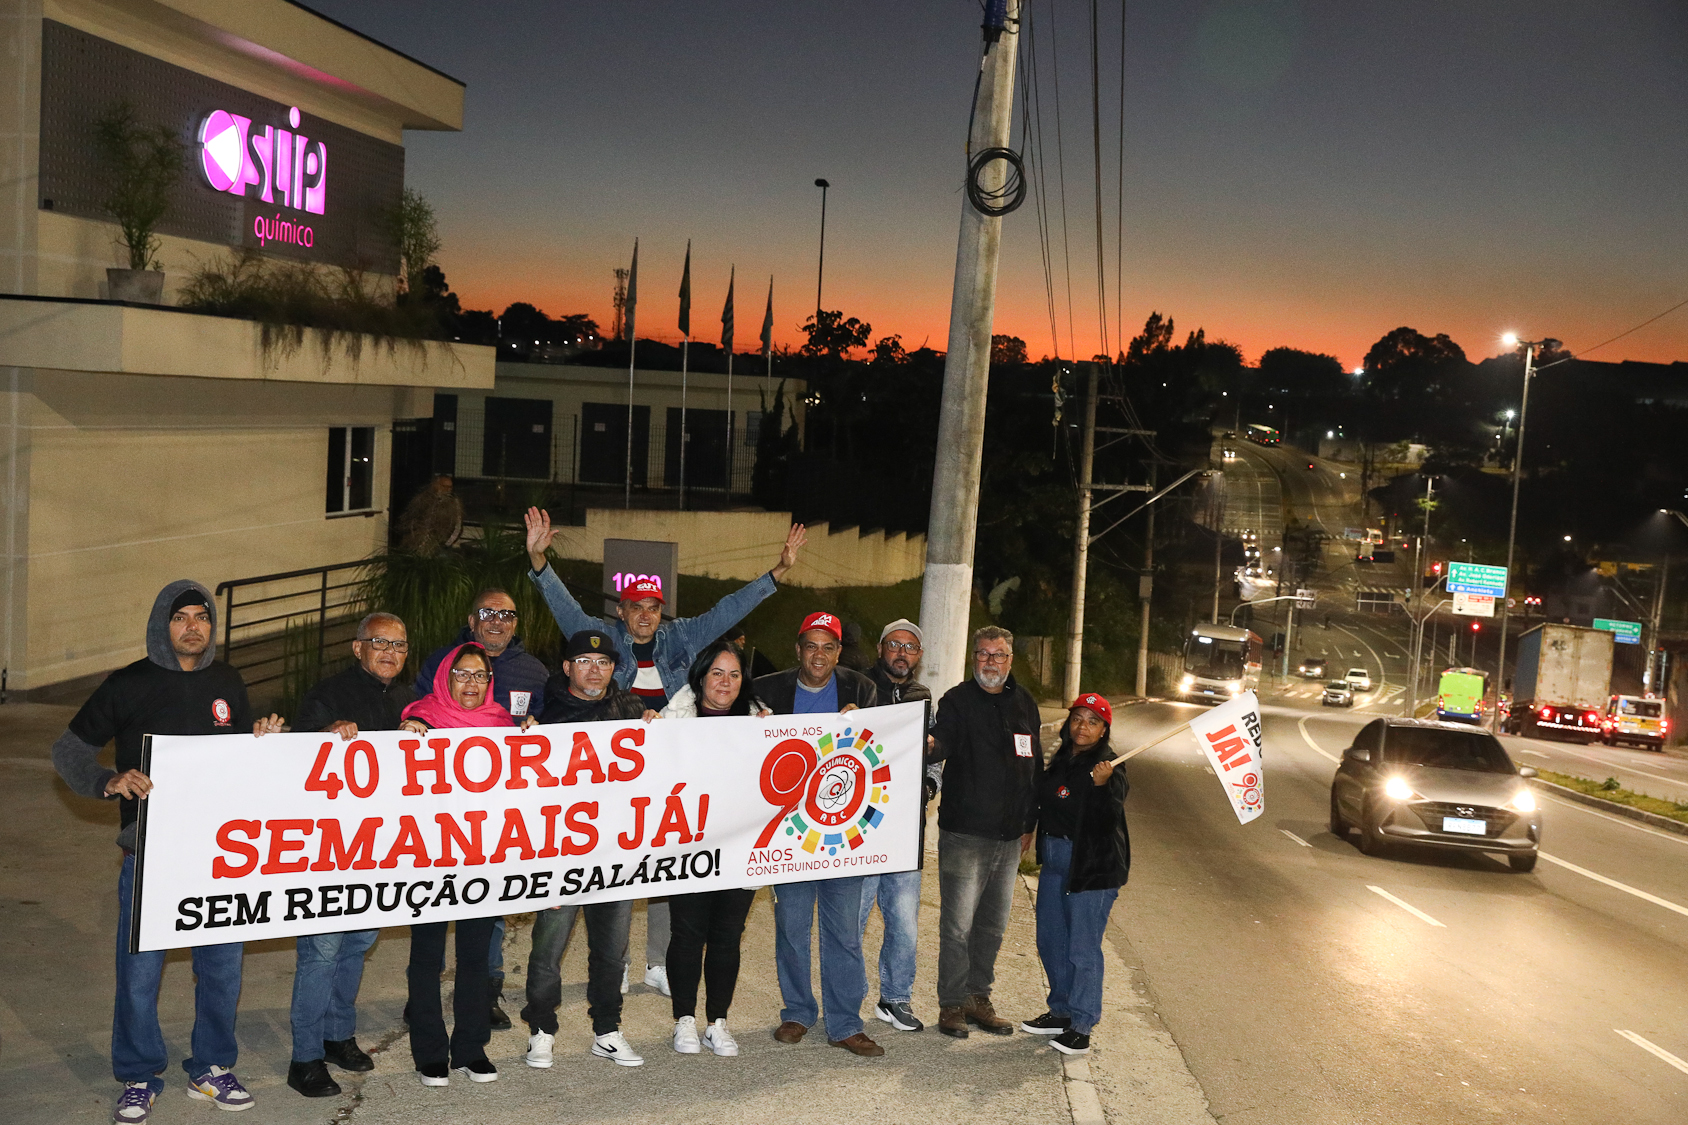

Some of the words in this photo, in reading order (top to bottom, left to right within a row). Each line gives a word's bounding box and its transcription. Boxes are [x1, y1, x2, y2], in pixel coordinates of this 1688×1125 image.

[254, 213, 314, 248] química
[636, 582, 658, 590] CUT
[1466, 587, 1494, 595] Anchieta
[764, 728, 798, 738] RUMO
[802, 726, 823, 736] AOS
[1205, 723, 1252, 772] JÁ!
[305, 740, 380, 799] 40
[399, 728, 646, 797] HORAS
[819, 756, 860, 776] QUÍMICOS
[752, 738, 867, 849] 90
[212, 800, 600, 880] SEMANAIS
[618, 782, 711, 852] JÁ!
[746, 859, 830, 877] CONSTRUINDO
[833, 857, 841, 868] O
[843, 853, 889, 867] FUTURO
[747, 847, 793, 865] ANOS
[175, 890, 272, 932] SEM
[284, 874, 490, 922] REDUÇÃO
[499, 870, 553, 902] DE
[560, 849, 723, 897] SALÁRIO!
